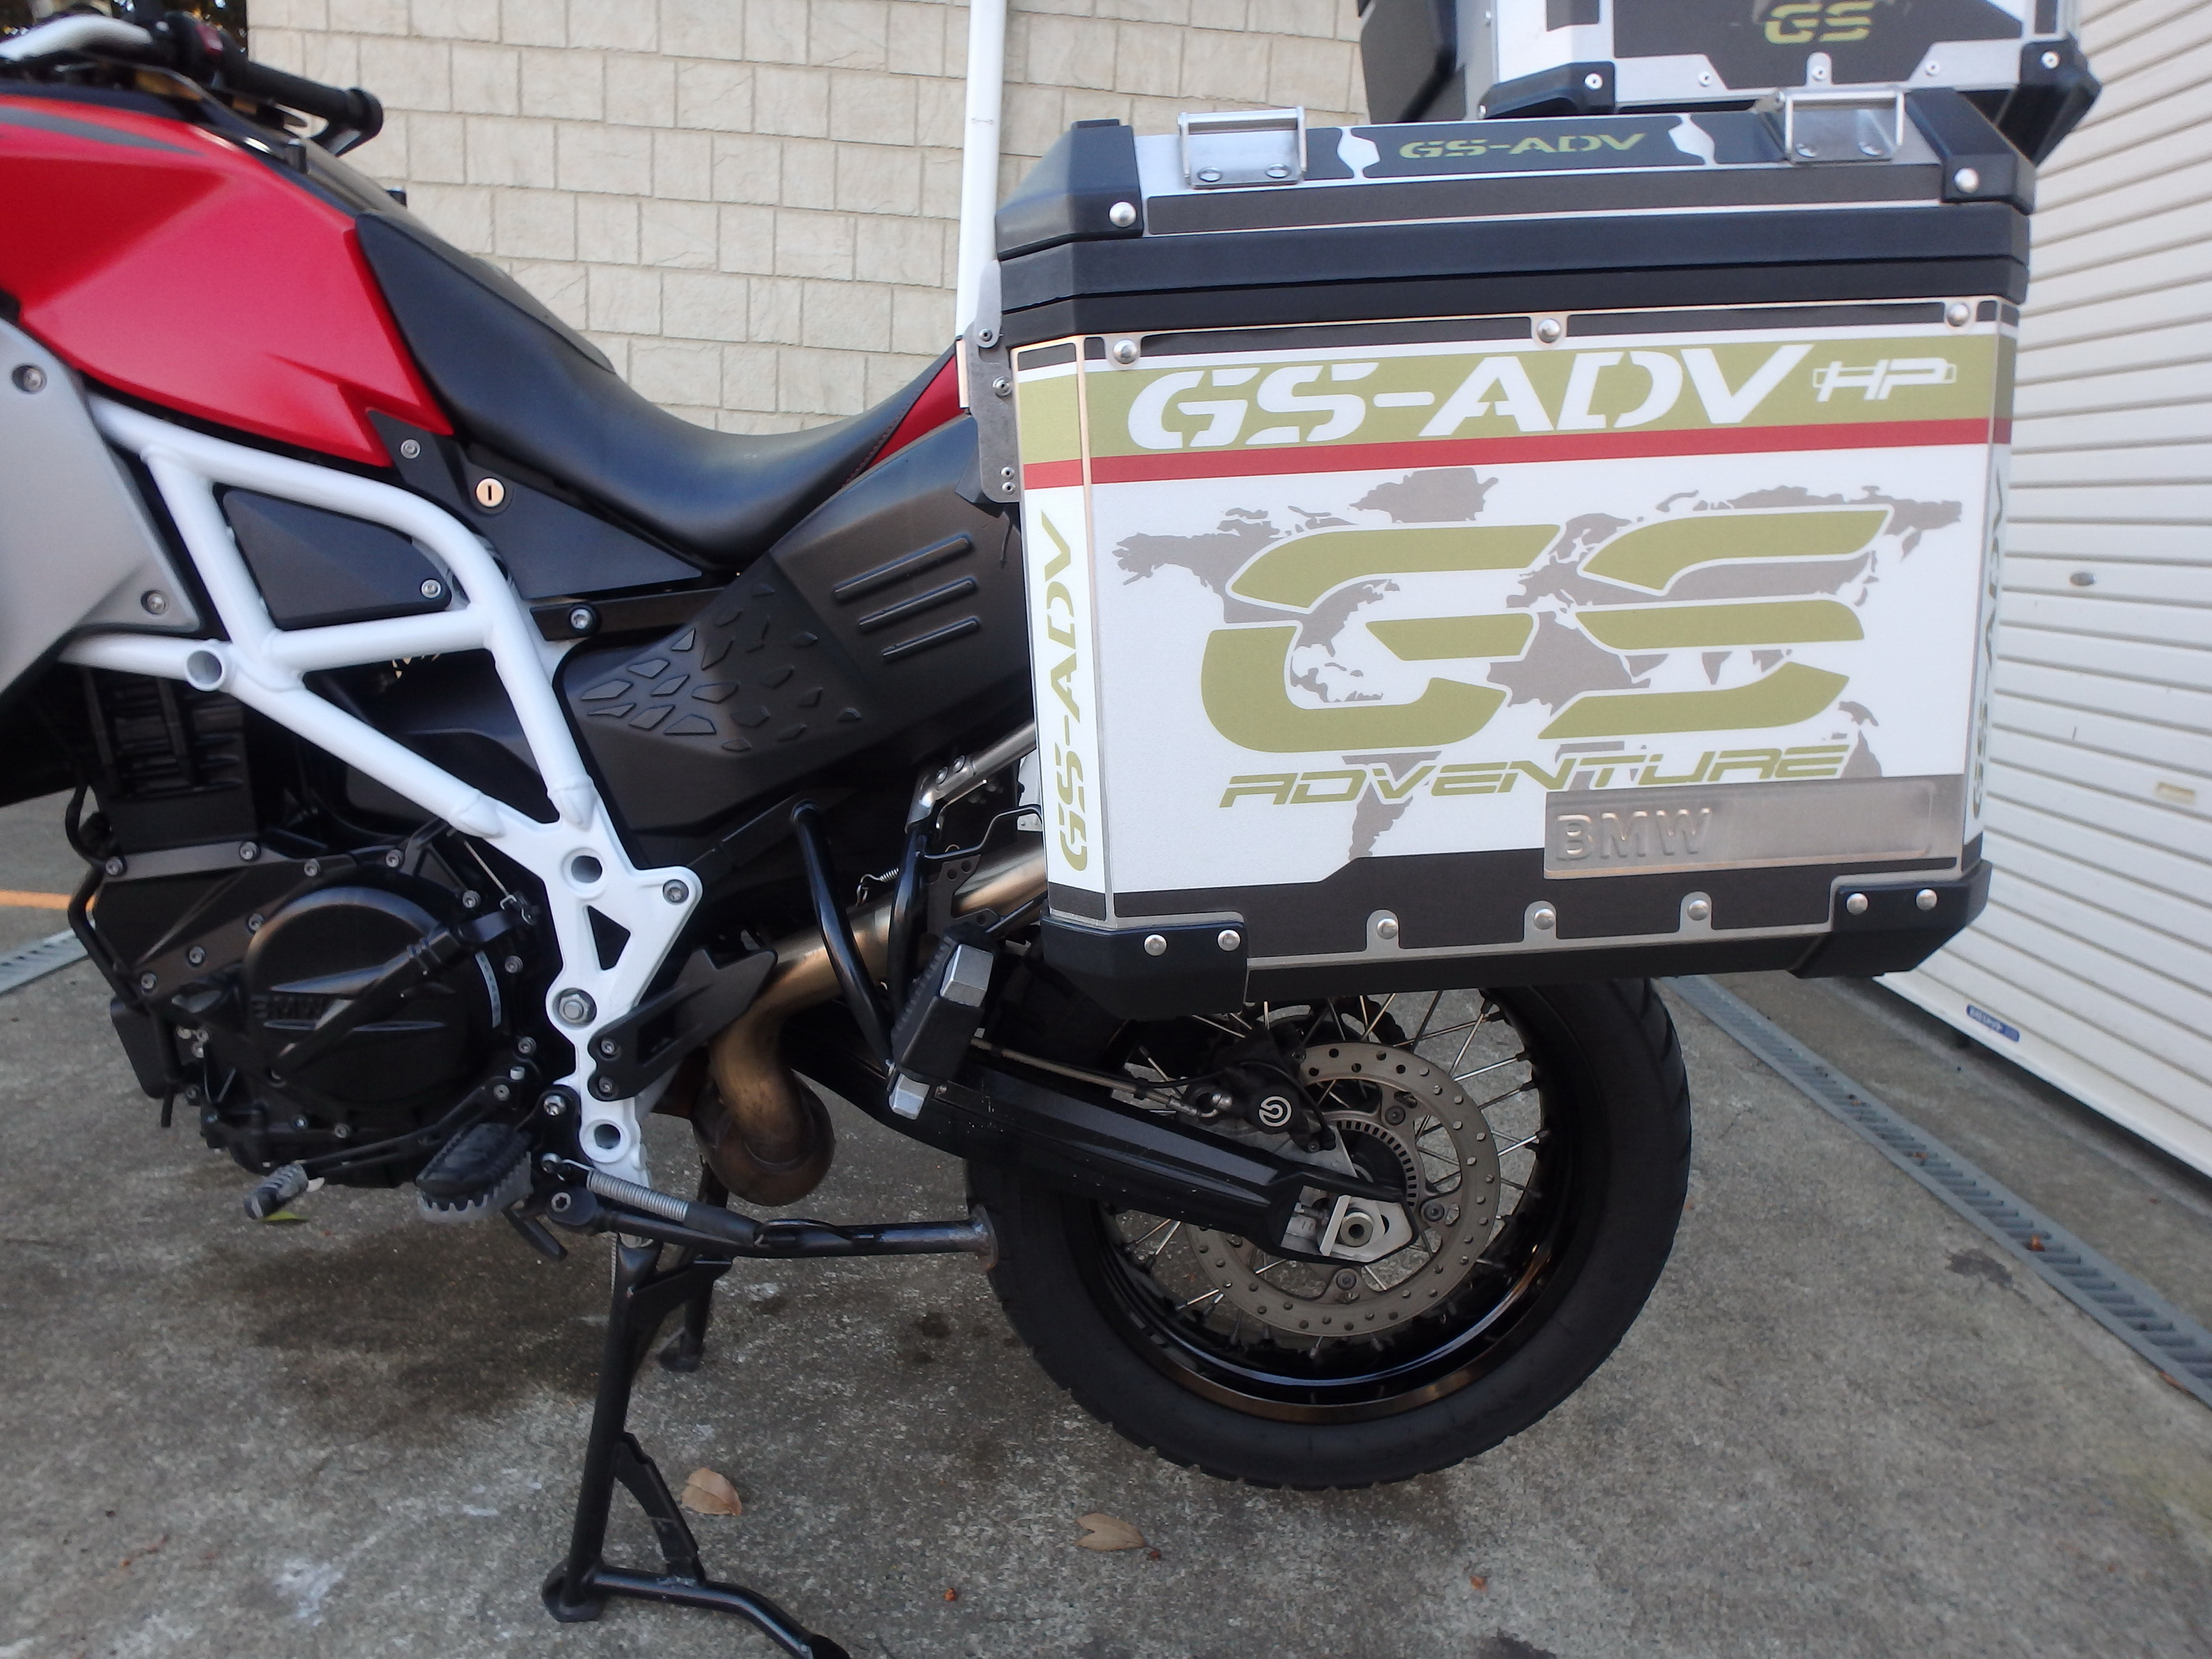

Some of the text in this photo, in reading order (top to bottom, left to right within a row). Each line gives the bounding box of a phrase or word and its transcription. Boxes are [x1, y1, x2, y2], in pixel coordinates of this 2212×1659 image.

[1764, 1, 1875, 45] GS
[1398, 132, 1647, 159] GS-ADV
[1127, 344, 1954, 450] GS-ADV HP
[1201, 506, 1893, 753] GS
[1040, 509, 1088, 872] GS-ADV
[1218, 743, 1850, 808] ADVENTURE
[1556, 807, 1713, 862] BMW
